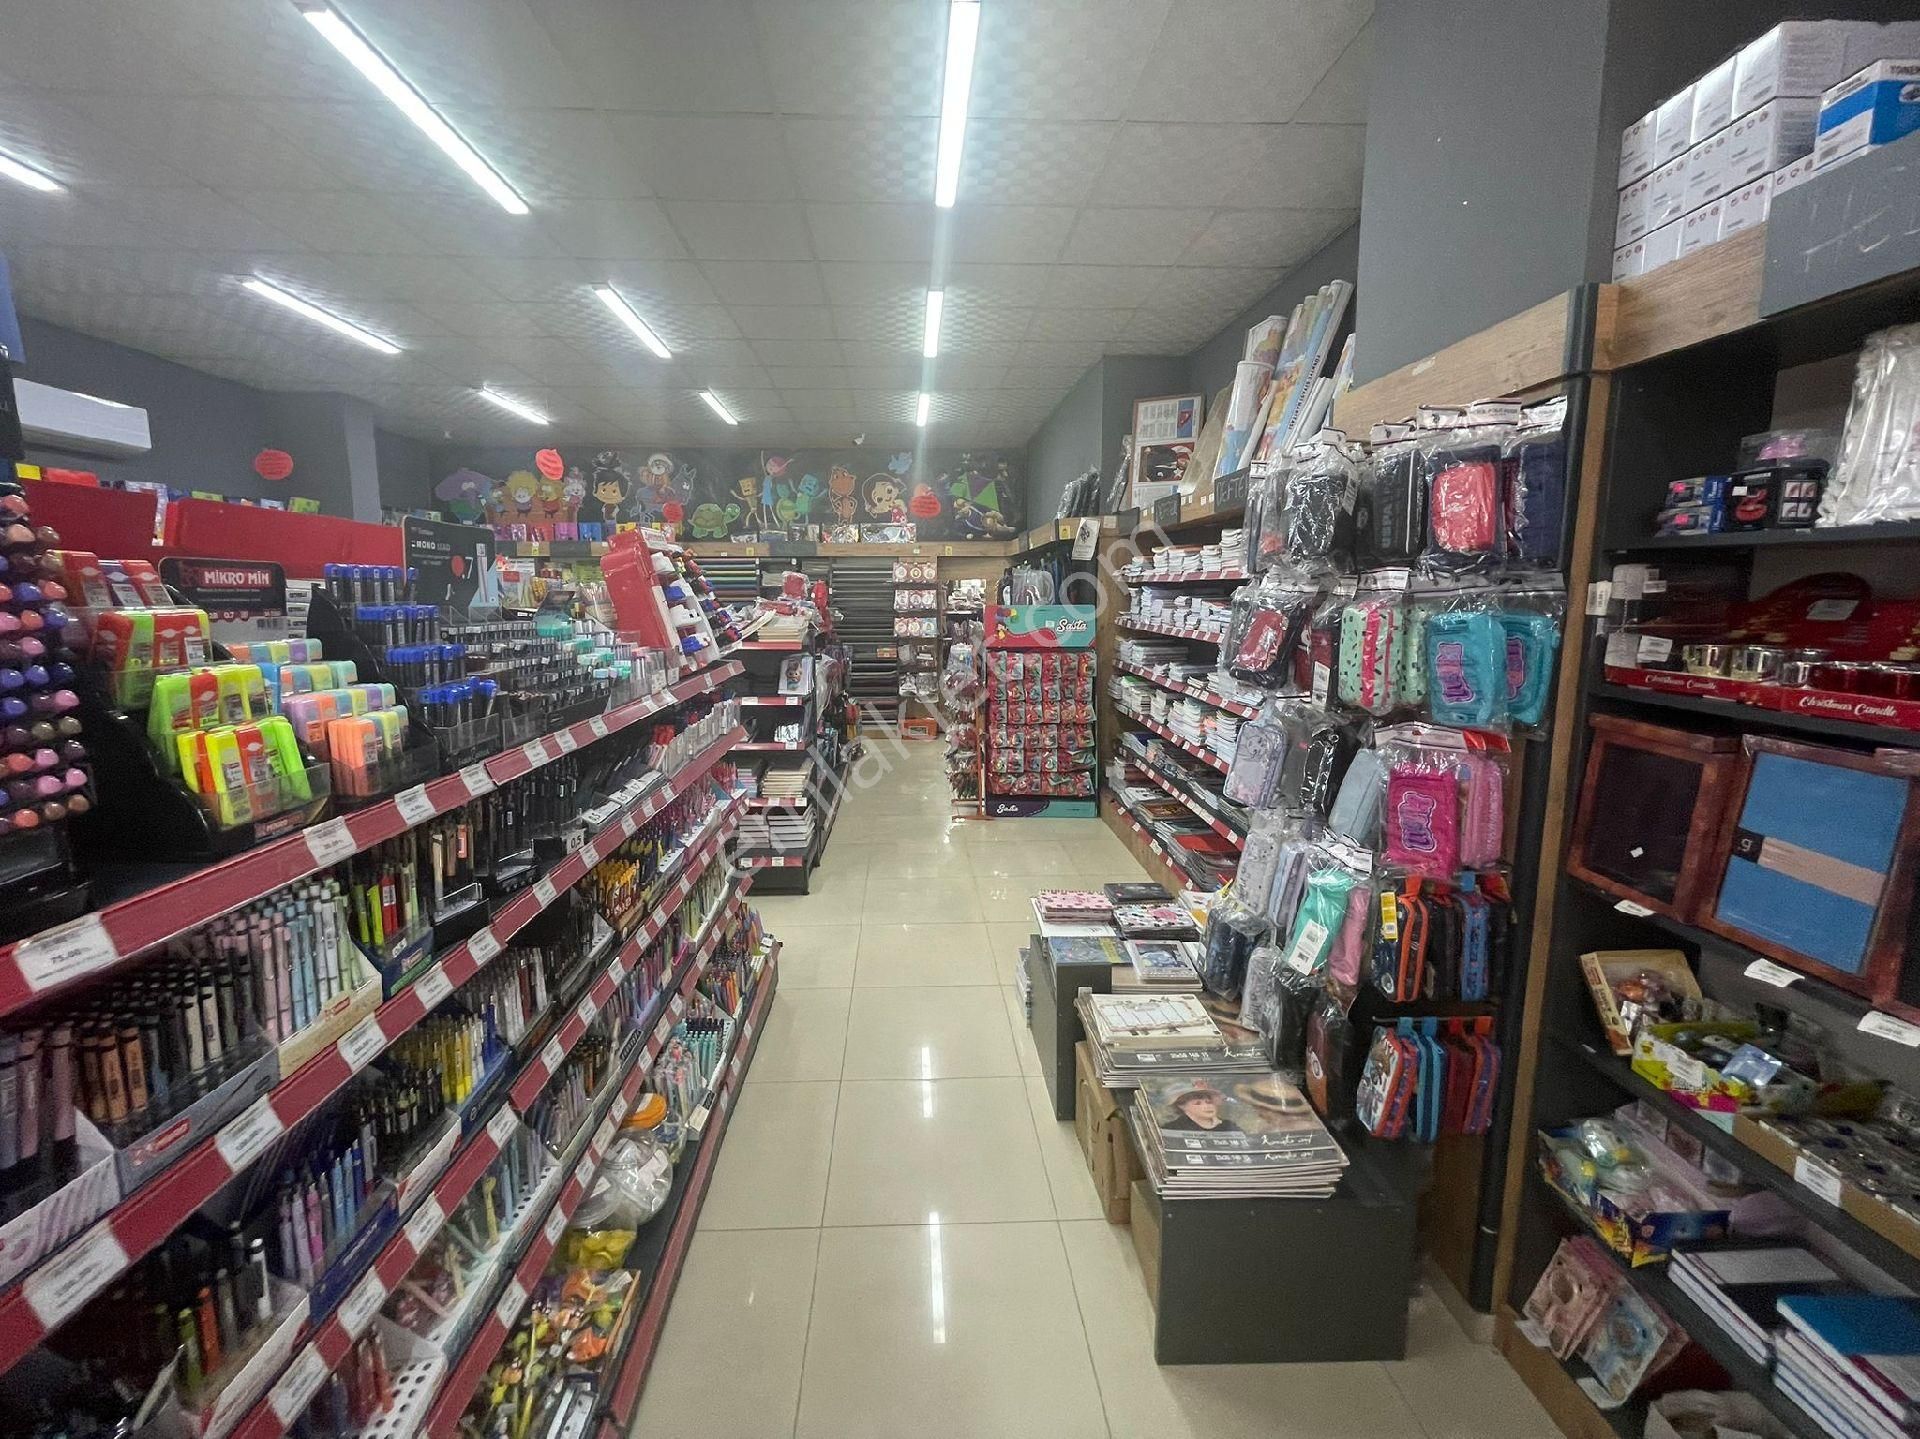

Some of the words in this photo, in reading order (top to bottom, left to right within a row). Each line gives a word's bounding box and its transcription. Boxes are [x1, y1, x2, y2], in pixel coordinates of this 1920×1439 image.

[204, 569, 244, 586] MİKRO
[248, 570, 270, 585] MİN
[1799, 695, 1853, 711] Christmas
